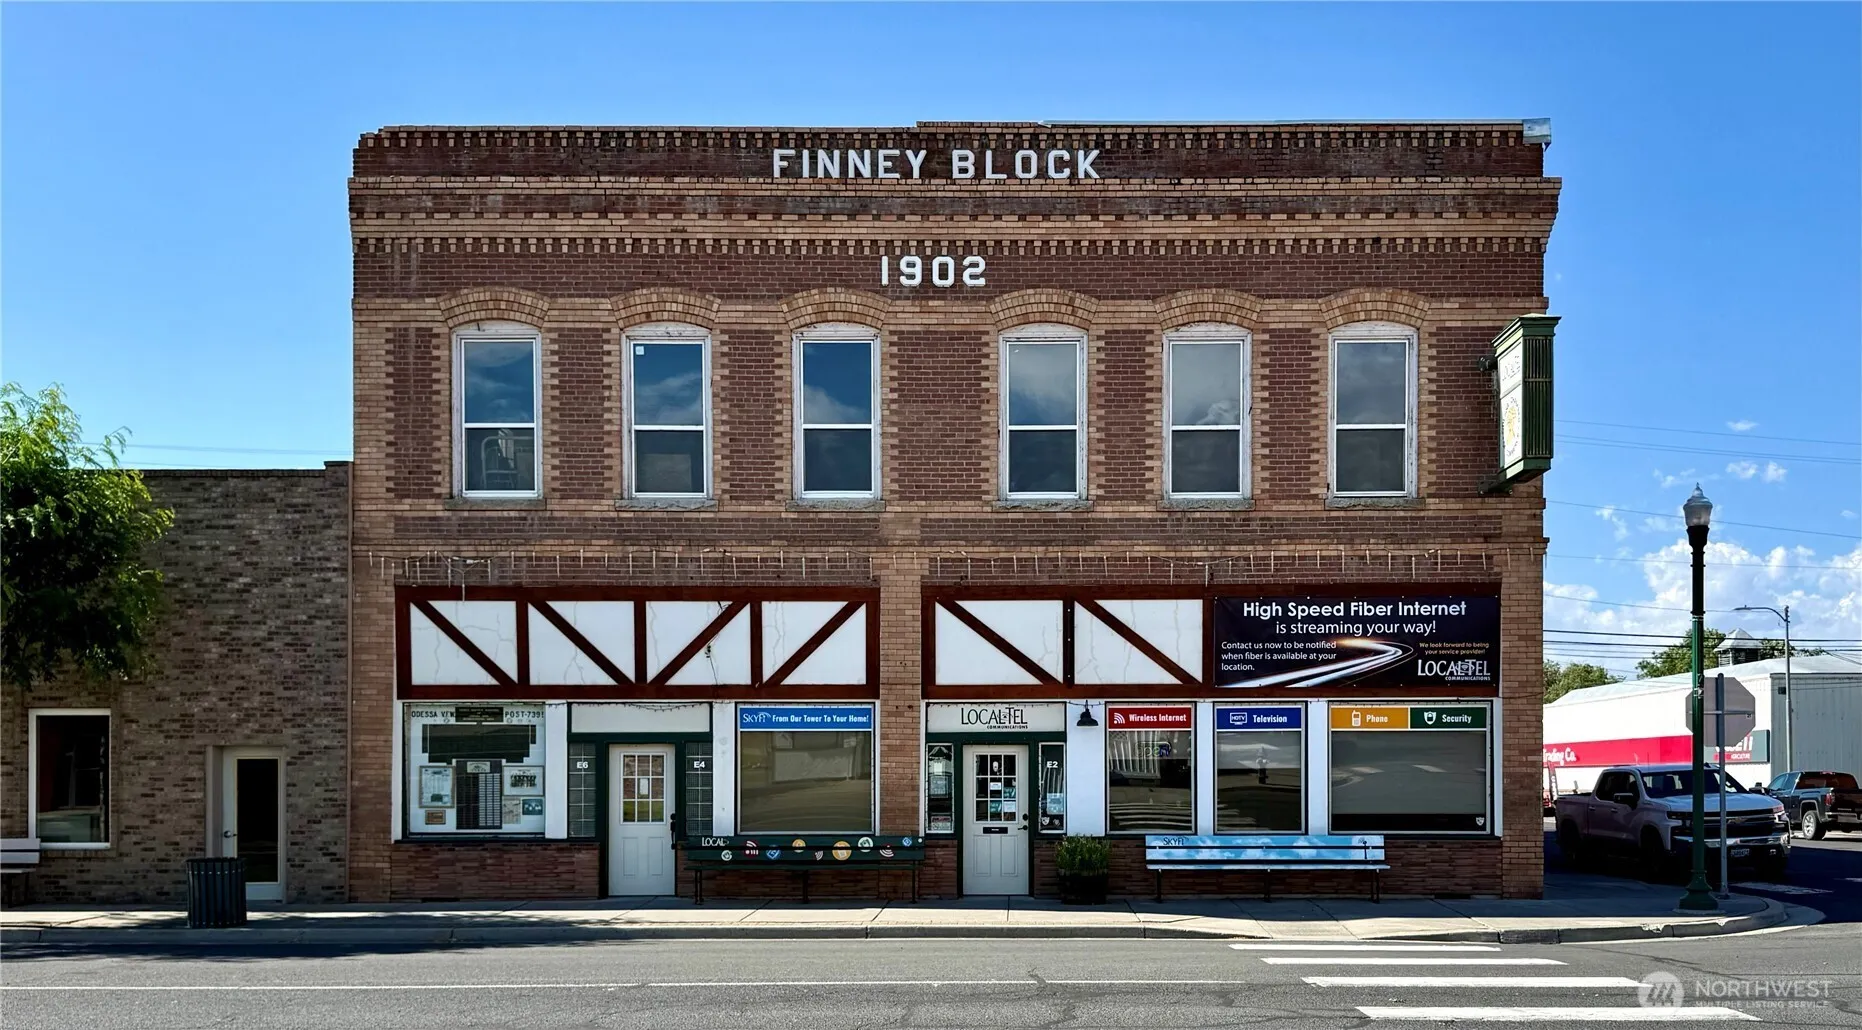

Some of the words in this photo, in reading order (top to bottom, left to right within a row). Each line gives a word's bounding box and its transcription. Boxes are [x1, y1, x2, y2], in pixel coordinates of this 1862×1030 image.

[773, 149, 927, 179] FINNEY
[952, 149, 1100, 179] BLOCK
[881, 255, 986, 287] 1902
[1243, 602, 1282, 620] High
[1287, 602, 1344, 619] Speed
[1350, 601, 1393, 616] Fiber
[1398, 601, 1466, 616] Internet
[1276, 621, 1287, 634] is
[1290, 621, 1363, 637] streaming
[1366, 623, 1400, 637] your
[1403, 620, 1436, 636] way!
[1221, 641, 1252, 649] Contact
[1293, 641, 1304, 649] be
[1305, 641, 1337, 649] notified
[1221, 651, 1243, 660] when
[1245, 651, 1263, 660] fiber
[1264, 651, 1271, 660] is
[1272, 651, 1307, 660] available
[1318, 653, 1337, 661] your
[1221, 662, 1255, 671] location.
[411, 710, 438, 718] ODESSA
[1129, 714, 1157, 722] Wireless
[1159, 714, 1187, 722] Internet
[1253, 714, 1288, 723] Television
[1366, 714, 1389, 723] Phone
[1442, 714, 1472, 724] Security
[576, 761, 588, 769] E6
[693, 761, 705, 769] E4
[1046, 761, 1058, 769] E2
